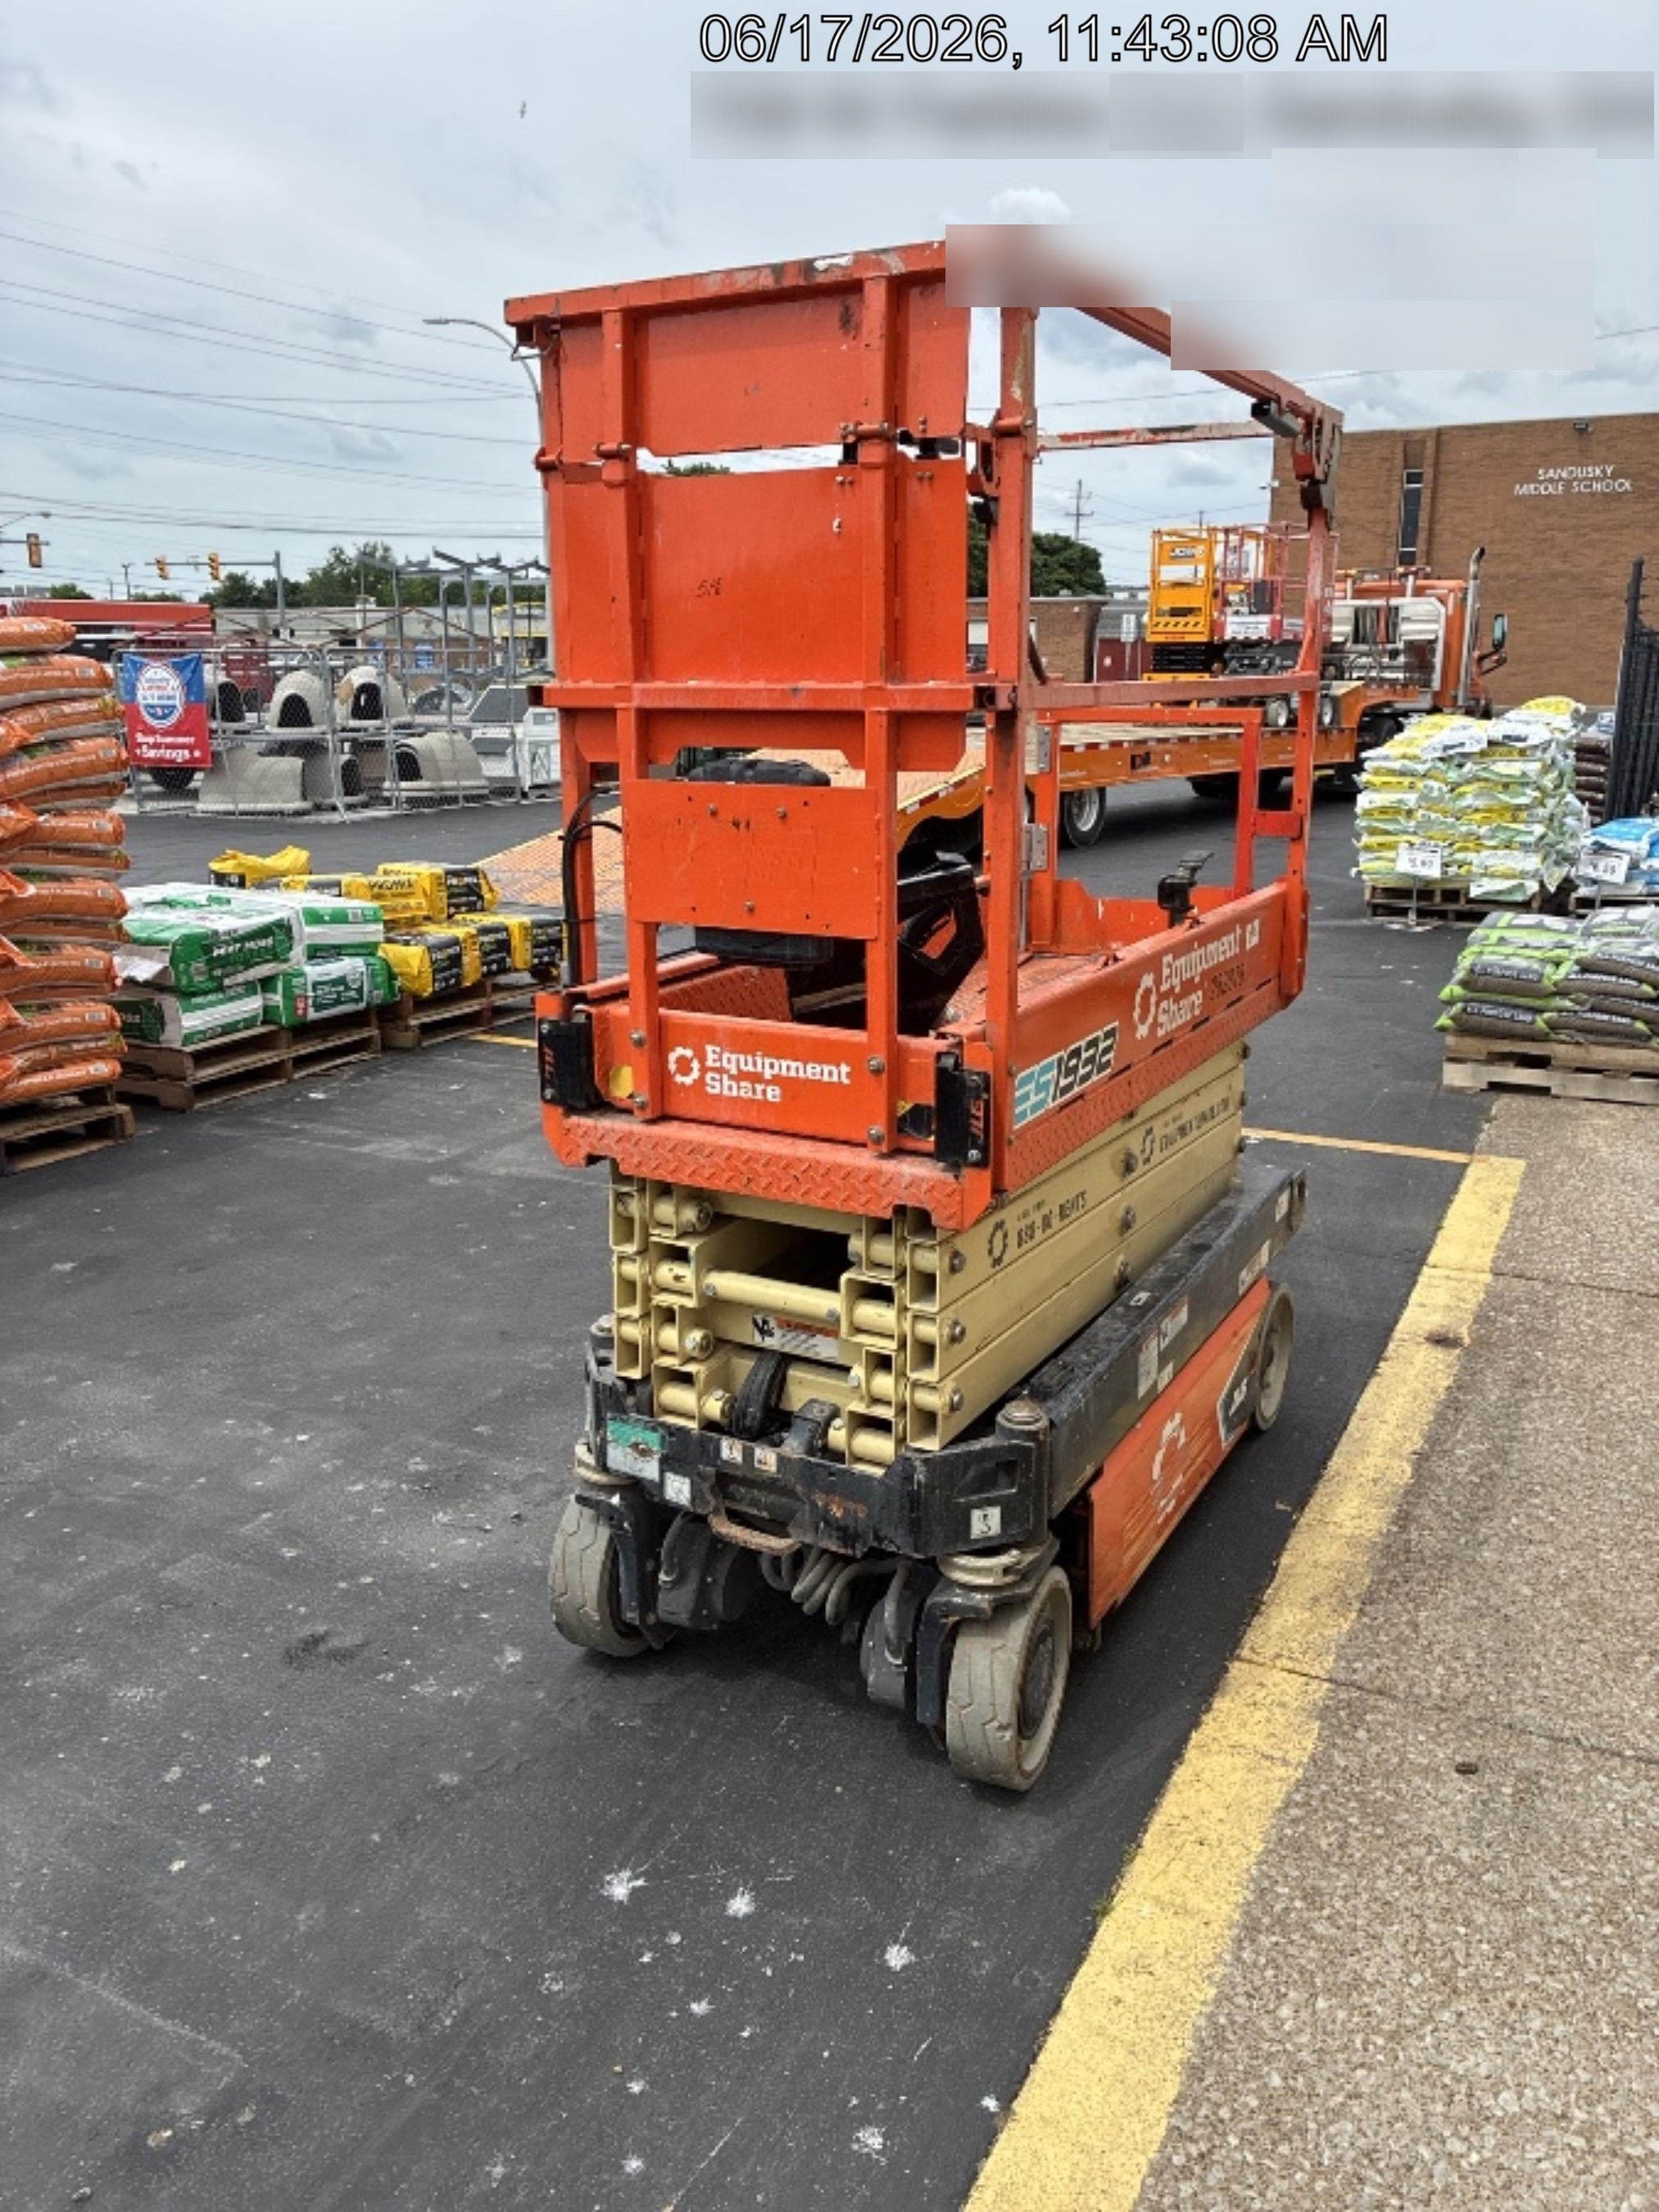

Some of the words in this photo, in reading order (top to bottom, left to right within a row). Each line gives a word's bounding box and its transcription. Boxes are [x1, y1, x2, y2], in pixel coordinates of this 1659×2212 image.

[1514, 482, 1566, 495] MIDDLE
[1571, 479, 1633, 493] SCHOOL
[1538, 465, 1614, 480] SANDUSKY
[1160, 923, 1243, 994] Equipment
[1157, 989, 1203, 1038] Share
[705, 1044, 851, 1085] Equipment
[705, 1072, 782, 1103] Share
